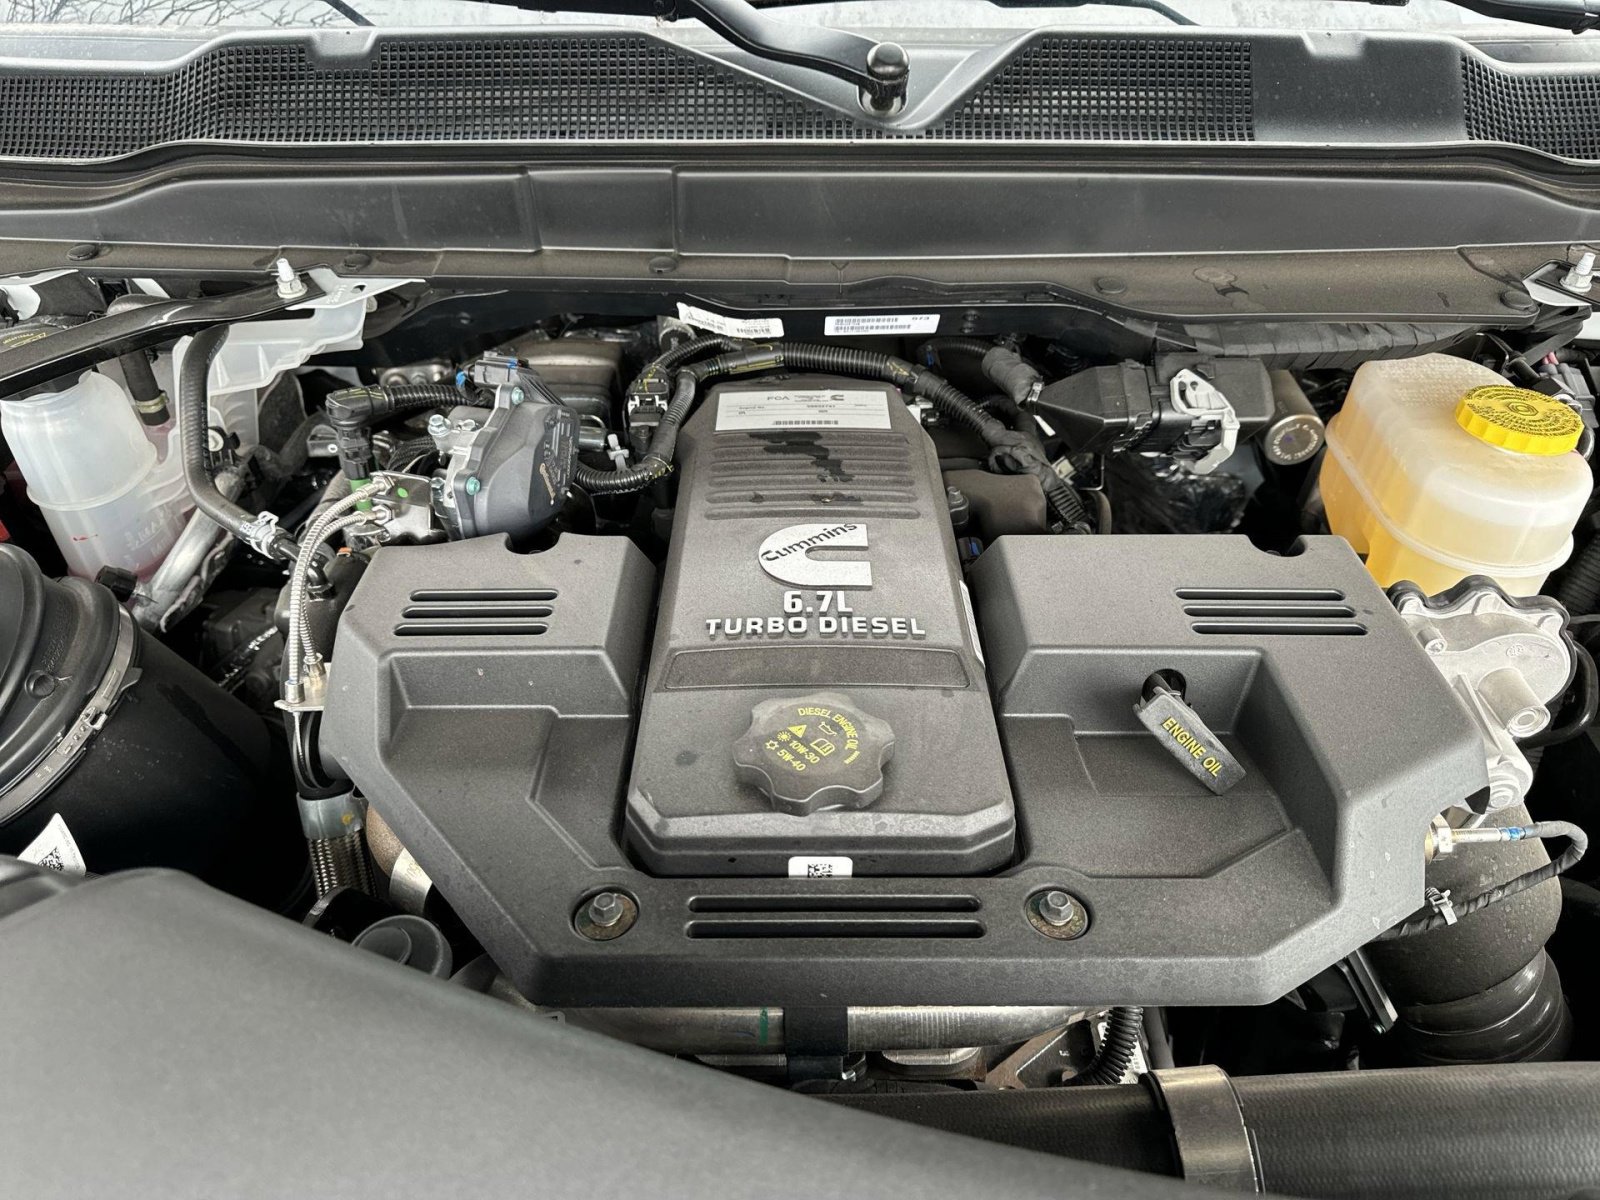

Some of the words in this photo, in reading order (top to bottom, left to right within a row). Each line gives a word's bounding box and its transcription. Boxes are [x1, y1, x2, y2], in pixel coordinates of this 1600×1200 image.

[761, 523, 858, 562] Cummins
[783, 590, 853, 614] 6.7L
[705, 617, 808, 638] TURBO
[819, 616, 926, 638] DIESEL
[797, 707, 832, 719] DIESEL
[832, 713, 859, 738] ENGINE
[788, 740, 821, 765] 10W-30
[844, 739, 859, 750] OIL
[1161, 715, 1207, 760] ENGINE
[1202, 756, 1223, 778] OIL
[776, 749, 807, 772] 5W-40
